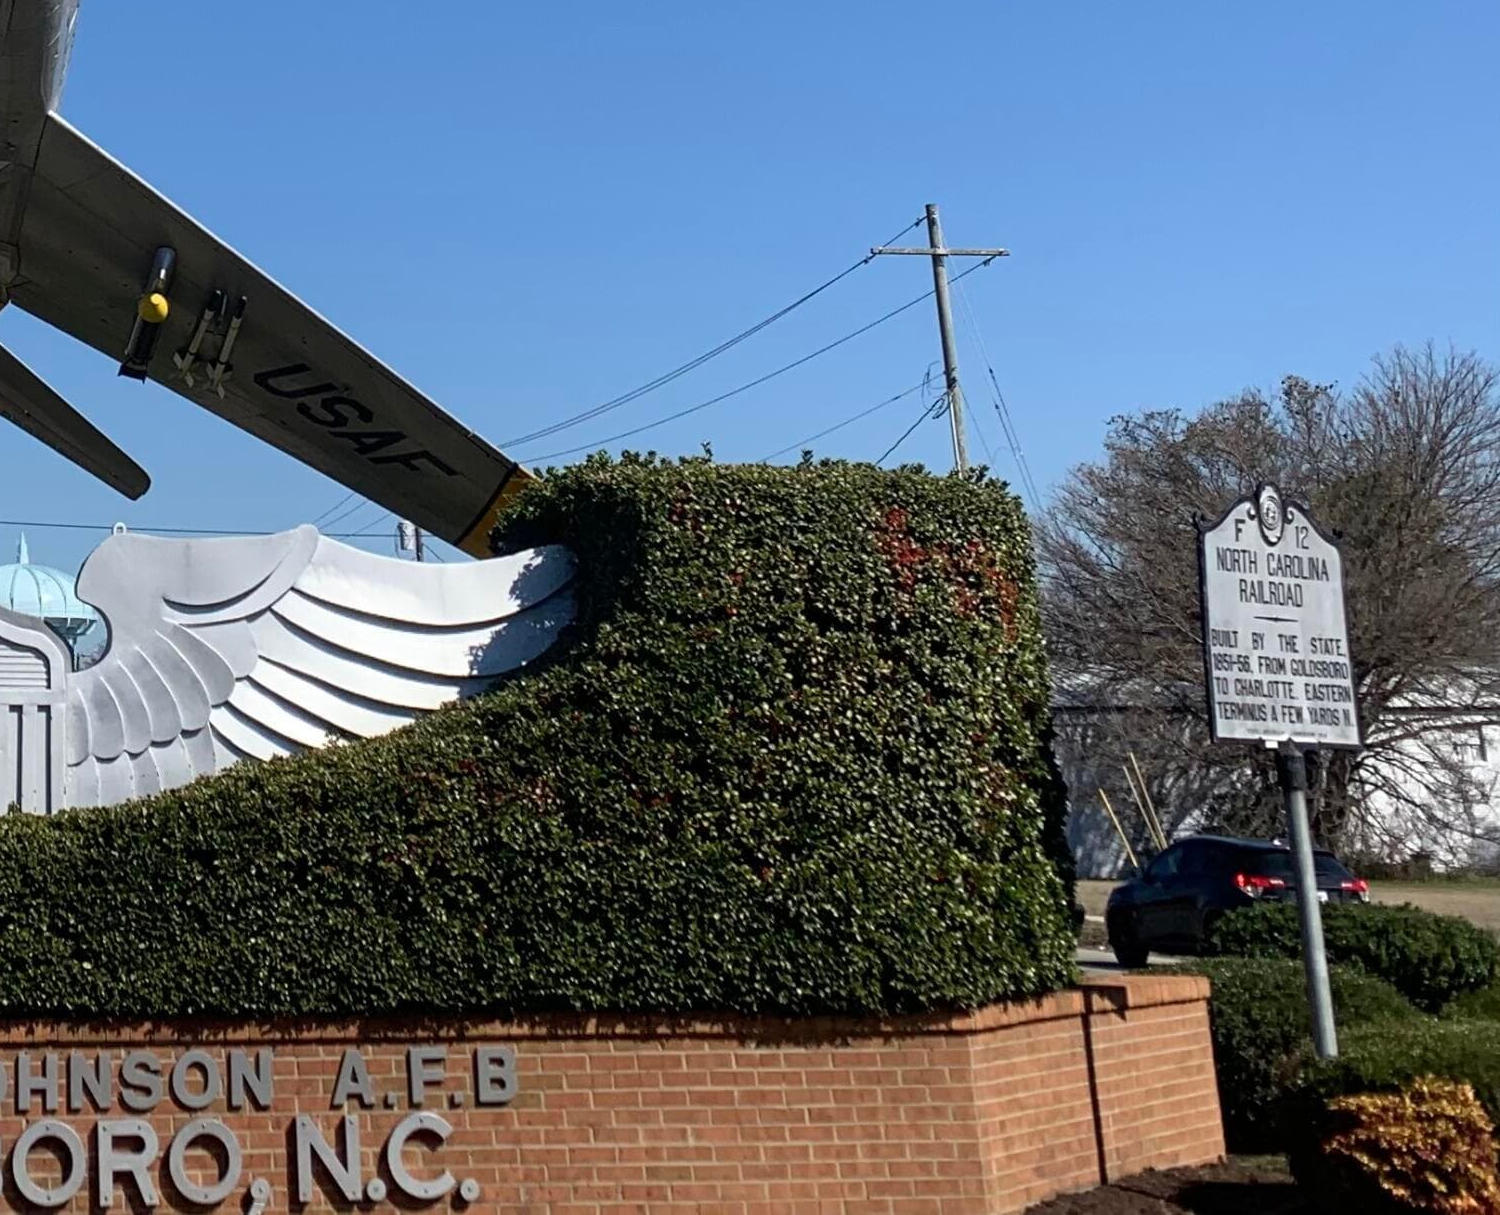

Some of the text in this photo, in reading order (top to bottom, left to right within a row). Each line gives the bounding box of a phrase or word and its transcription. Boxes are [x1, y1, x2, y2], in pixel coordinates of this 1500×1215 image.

[253, 361, 460, 479] USAF
[1234, 518, 1310, 550] F 12
[1216, 546, 1330, 582] NORTH CAROLINA
[1239, 578, 1304, 608] RAILROAD
[1211, 628, 1239, 649] BUILT
[1251, 631, 1265, 651] BY
[1277, 633, 1300, 654] THE
[1257, 655, 1288, 676] FROM
[1290, 658, 1350, 680] GOLDSBORO
[1214, 676, 1229, 696] TO
[1304, 682, 1352, 703] EASTERN
[1216, 701, 1268, 723] TERMINUS
[1270, 704, 1279, 723] A
[1280, 704, 1304, 725] FEW
[1306, 706, 1341, 727] YARDS
[332, 1044, 519, 1108] A.F.B
[295, 1110, 480, 1204] N.C.
